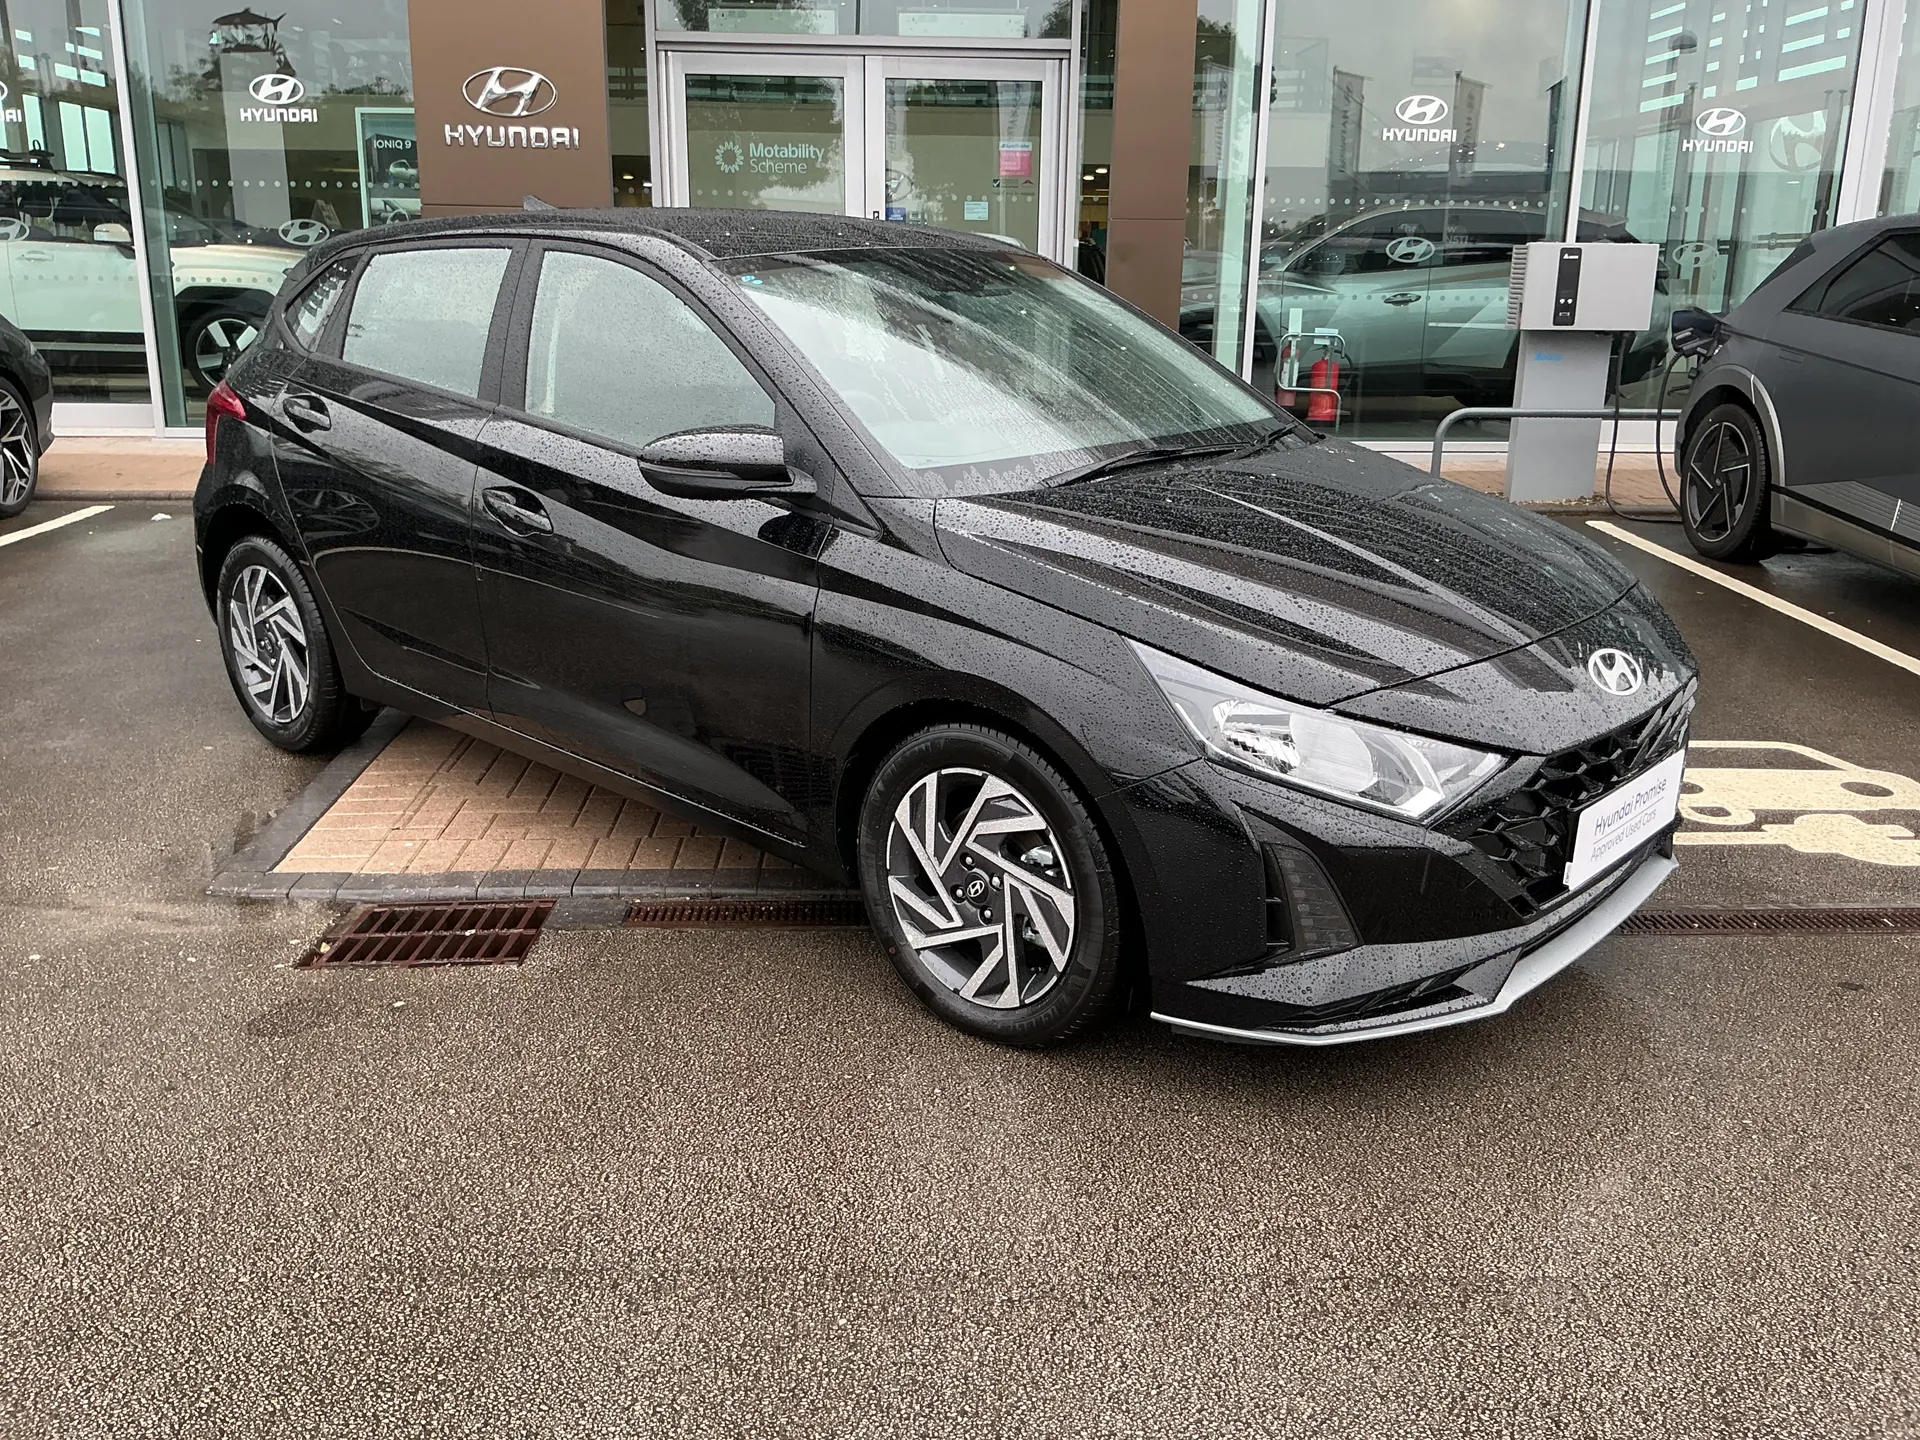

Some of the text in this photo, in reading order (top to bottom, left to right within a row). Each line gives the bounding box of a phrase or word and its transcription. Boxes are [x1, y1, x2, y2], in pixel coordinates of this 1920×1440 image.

[240, 107, 318, 123] HYUNDAI
[444, 124, 580, 149] HYUNDAI
[1382, 127, 1457, 143] HYUNDAI
[373, 139, 412, 150] IONIQ 9
[749, 142, 825, 162] Motability
[1682, 139, 1754, 153] HYUNDAI
[749, 159, 808, 174] Scheme
[1594, 778, 1667, 837] Hyundai Promise
[1590, 808, 1657, 862] Approved Used Cars
